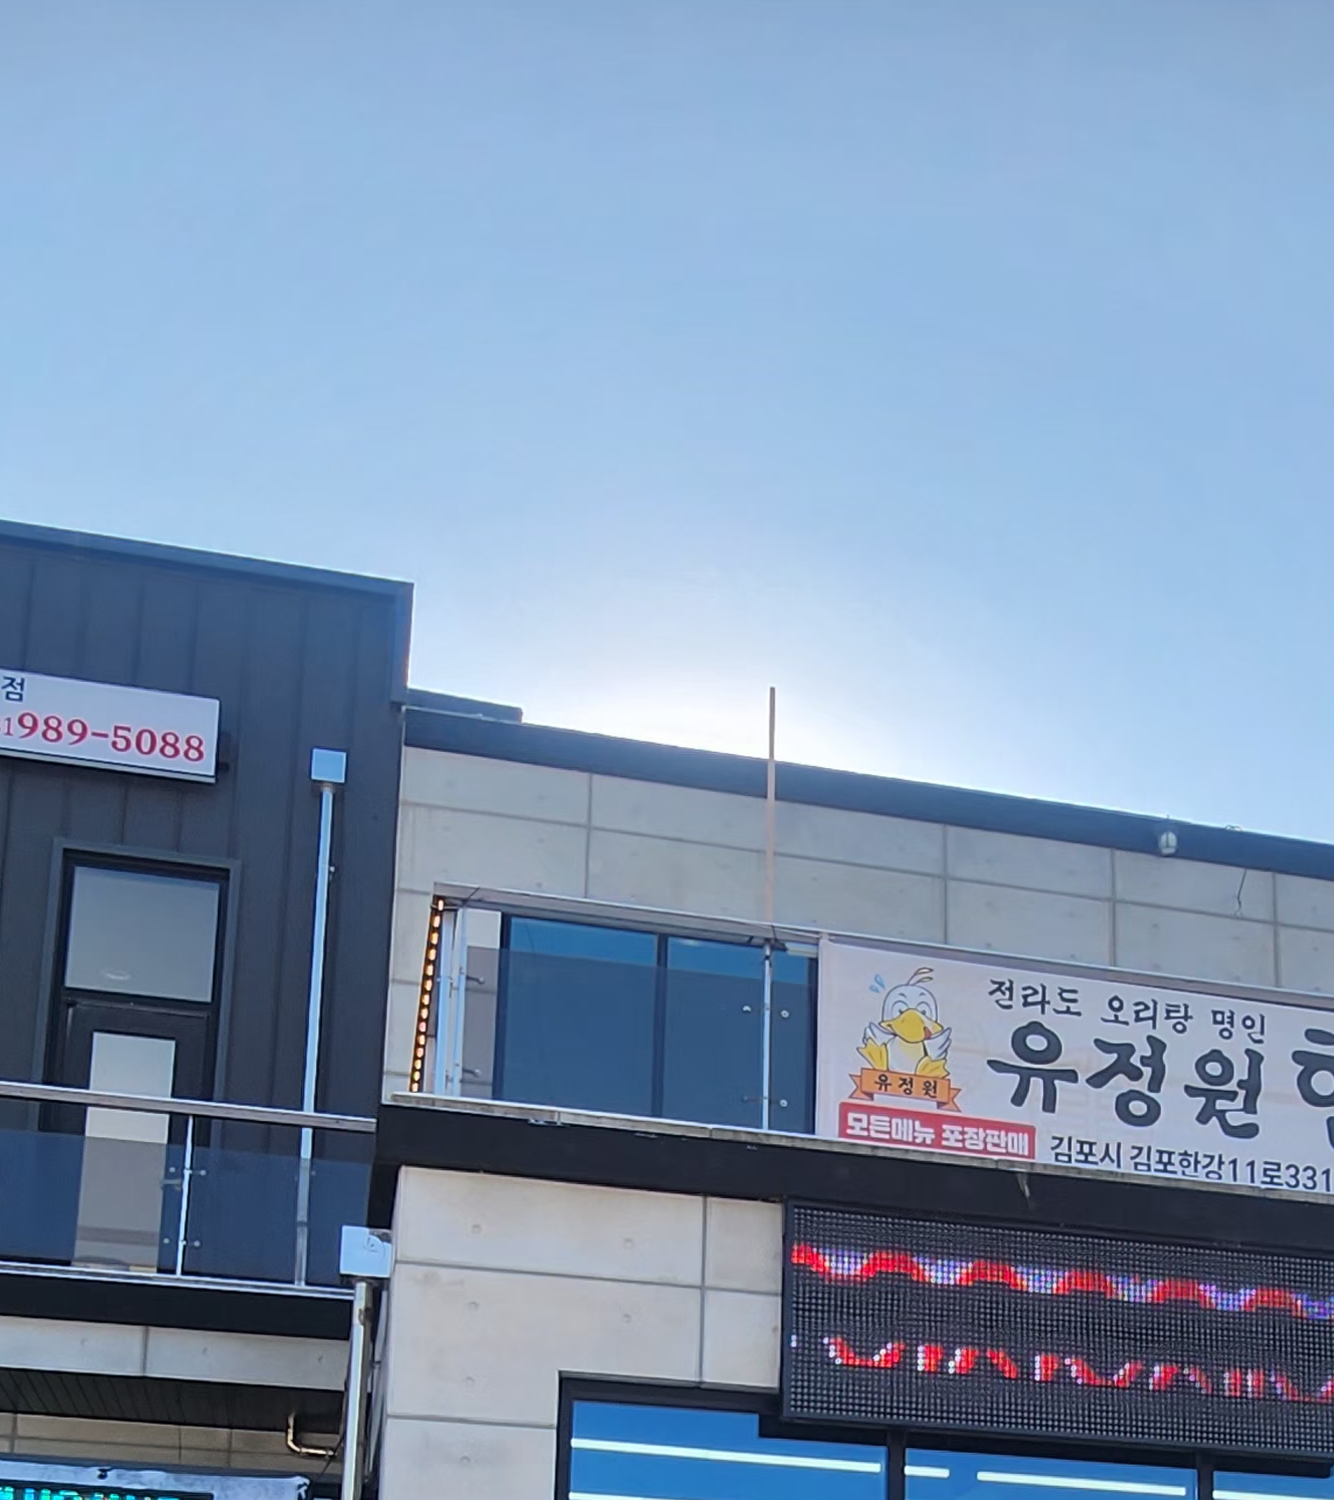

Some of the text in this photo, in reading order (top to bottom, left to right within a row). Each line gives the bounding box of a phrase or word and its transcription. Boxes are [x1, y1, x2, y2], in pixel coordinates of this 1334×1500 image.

[988, 978, 1266, 1044] 전라도 오리탕 명인
[873, 1073, 939, 1099] 유정원
[986, 1020, 1265, 1139] 유정원
[845, 1111, 1030, 1157] 모든메뉴 포장판매
[1049, 1134, 1123, 1170] 김포시
